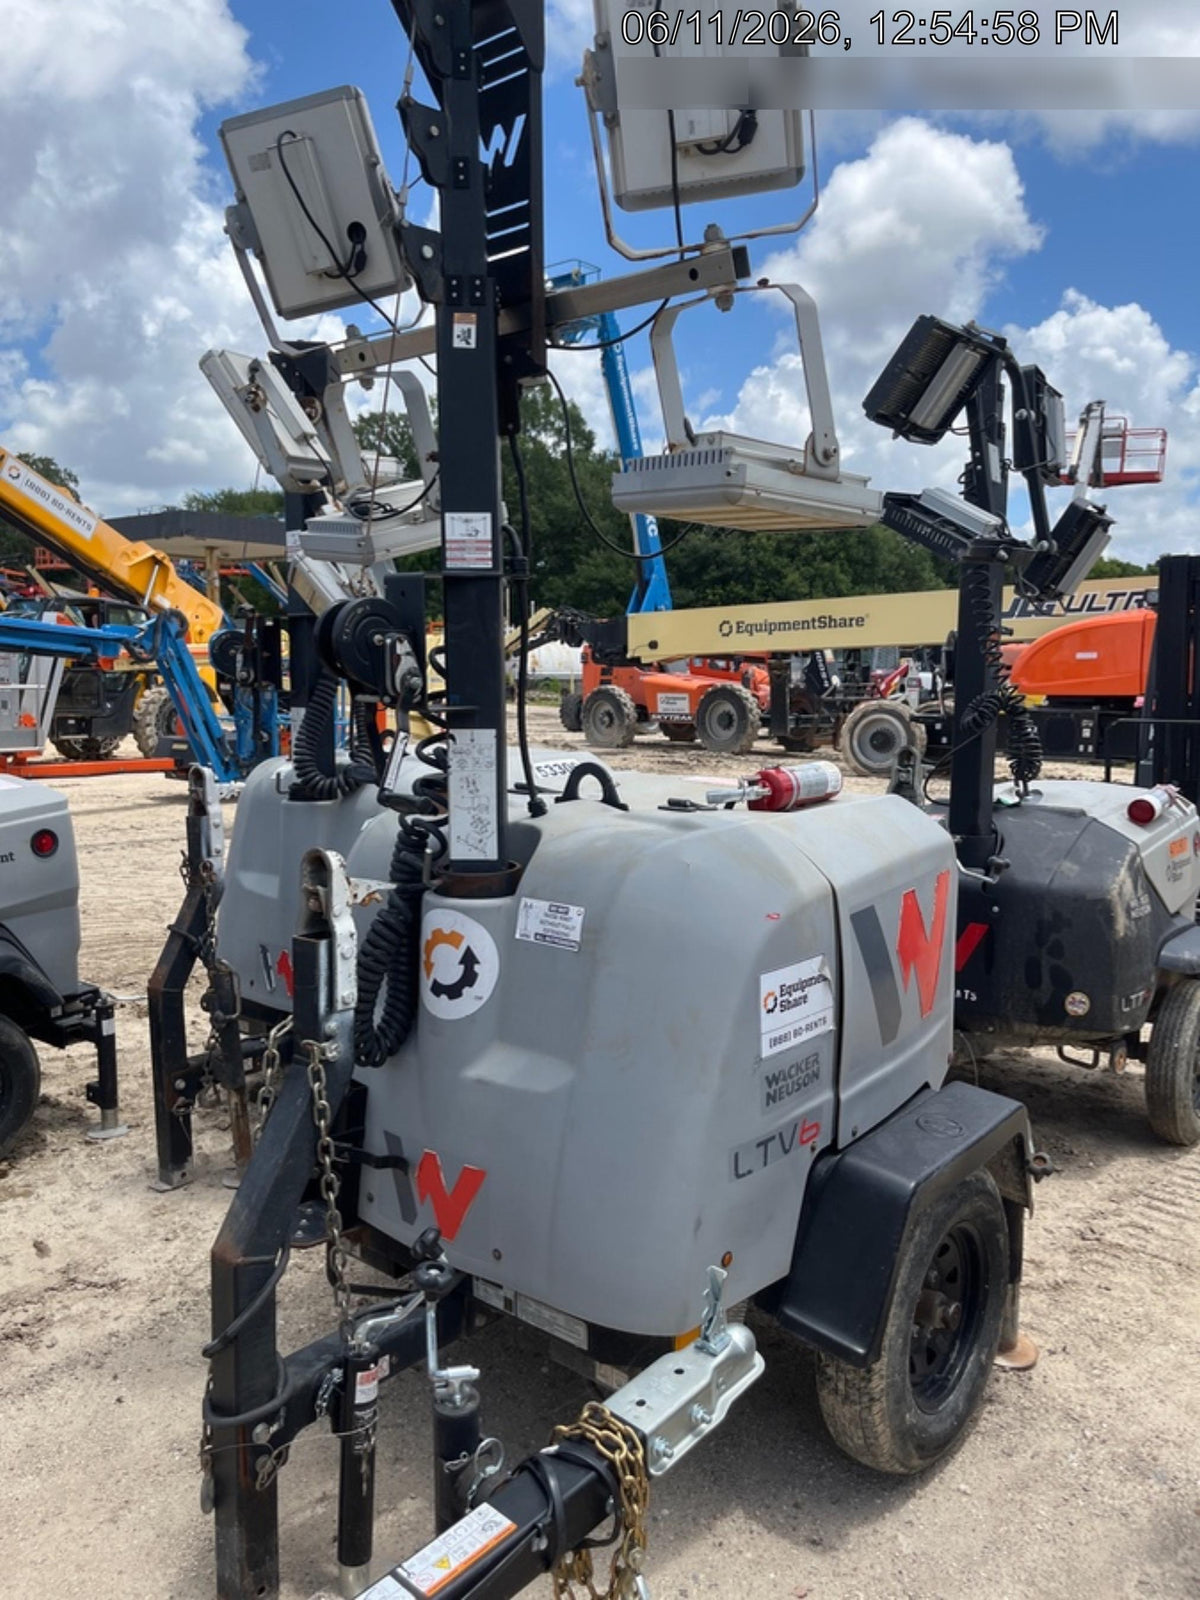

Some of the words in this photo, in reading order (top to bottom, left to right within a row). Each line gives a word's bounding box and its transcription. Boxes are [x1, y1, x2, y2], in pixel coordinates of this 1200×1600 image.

[735, 614, 866, 637] EquipmentShare
[779, 993, 809, 1013] Share
[764, 1051, 821, 1090] WACKER
[765, 1066, 821, 1107] NEUSON
